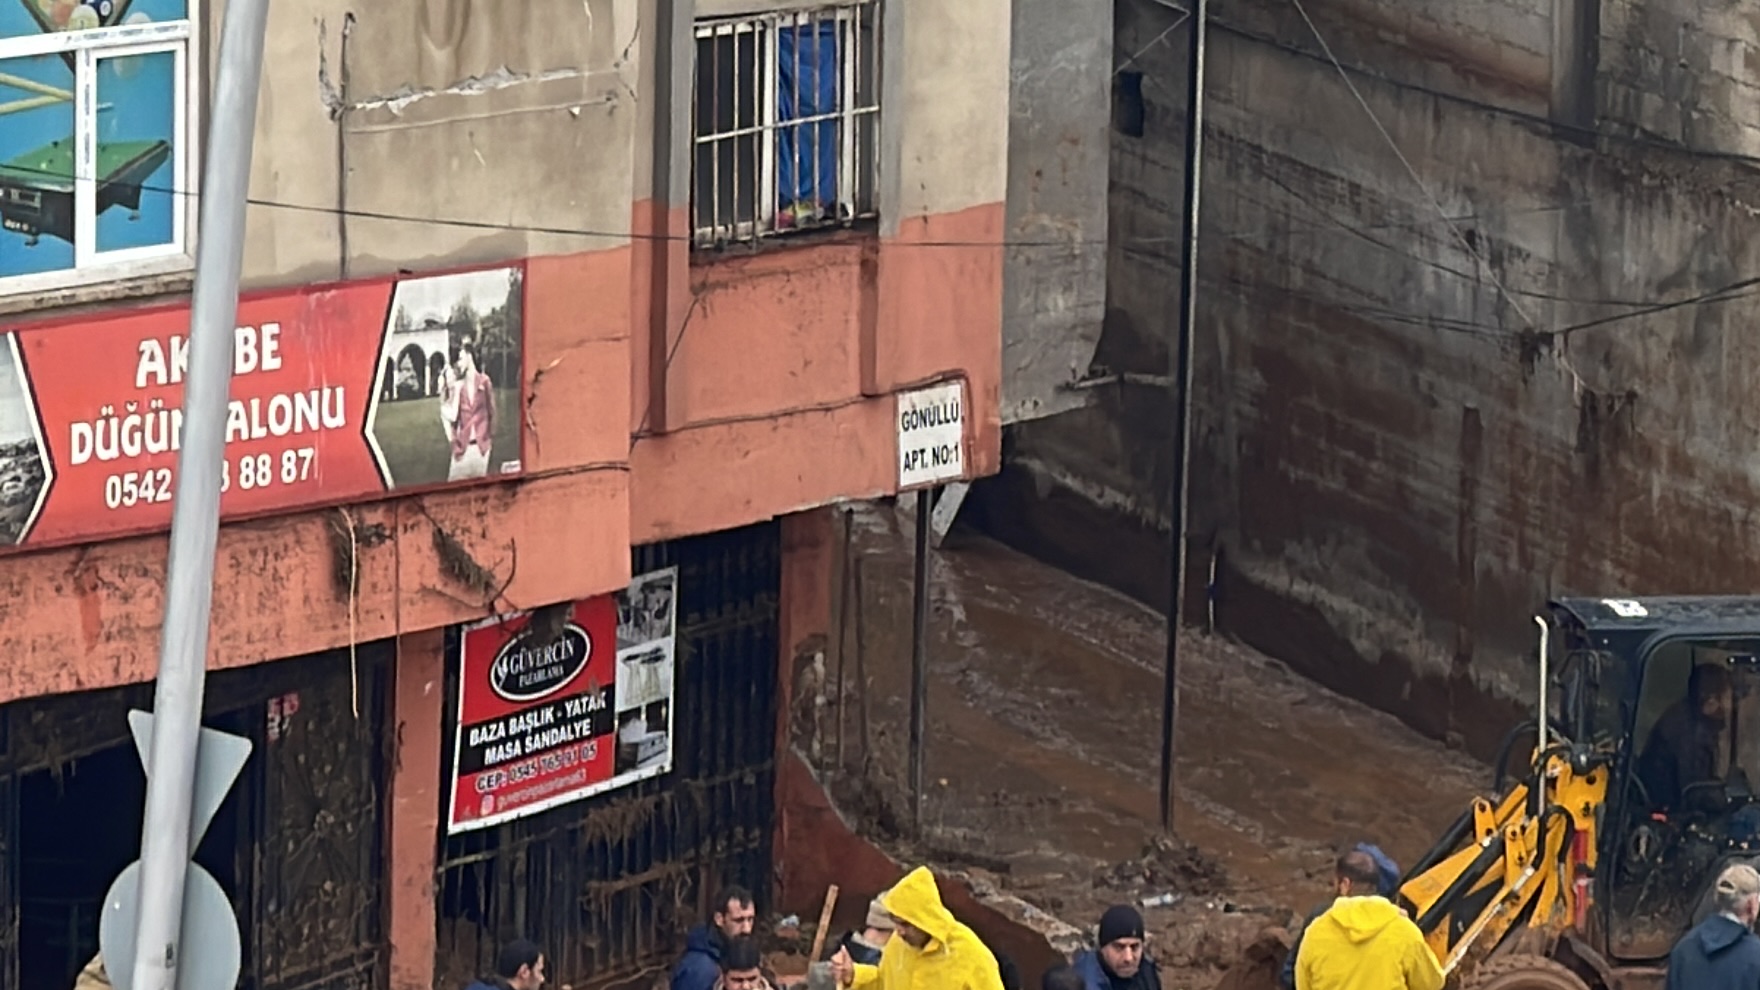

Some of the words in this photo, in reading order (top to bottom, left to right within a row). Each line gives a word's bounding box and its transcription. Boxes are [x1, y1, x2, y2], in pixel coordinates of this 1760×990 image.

[135, 323, 282, 388] AKBE
[225, 386, 346, 443] ALONU
[105, 468, 172, 509] 0542
[239, 453, 272, 489] 88
[281, 447, 314, 483] 87
[903, 447, 929, 473] APT.
[470, 722, 506, 747] BAZA
[509, 706, 555, 735] BAŞLIK
[565, 691, 607, 718] YATAK
[484, 740, 522, 766] MASA
[525, 719, 591, 753] SANDALYE
